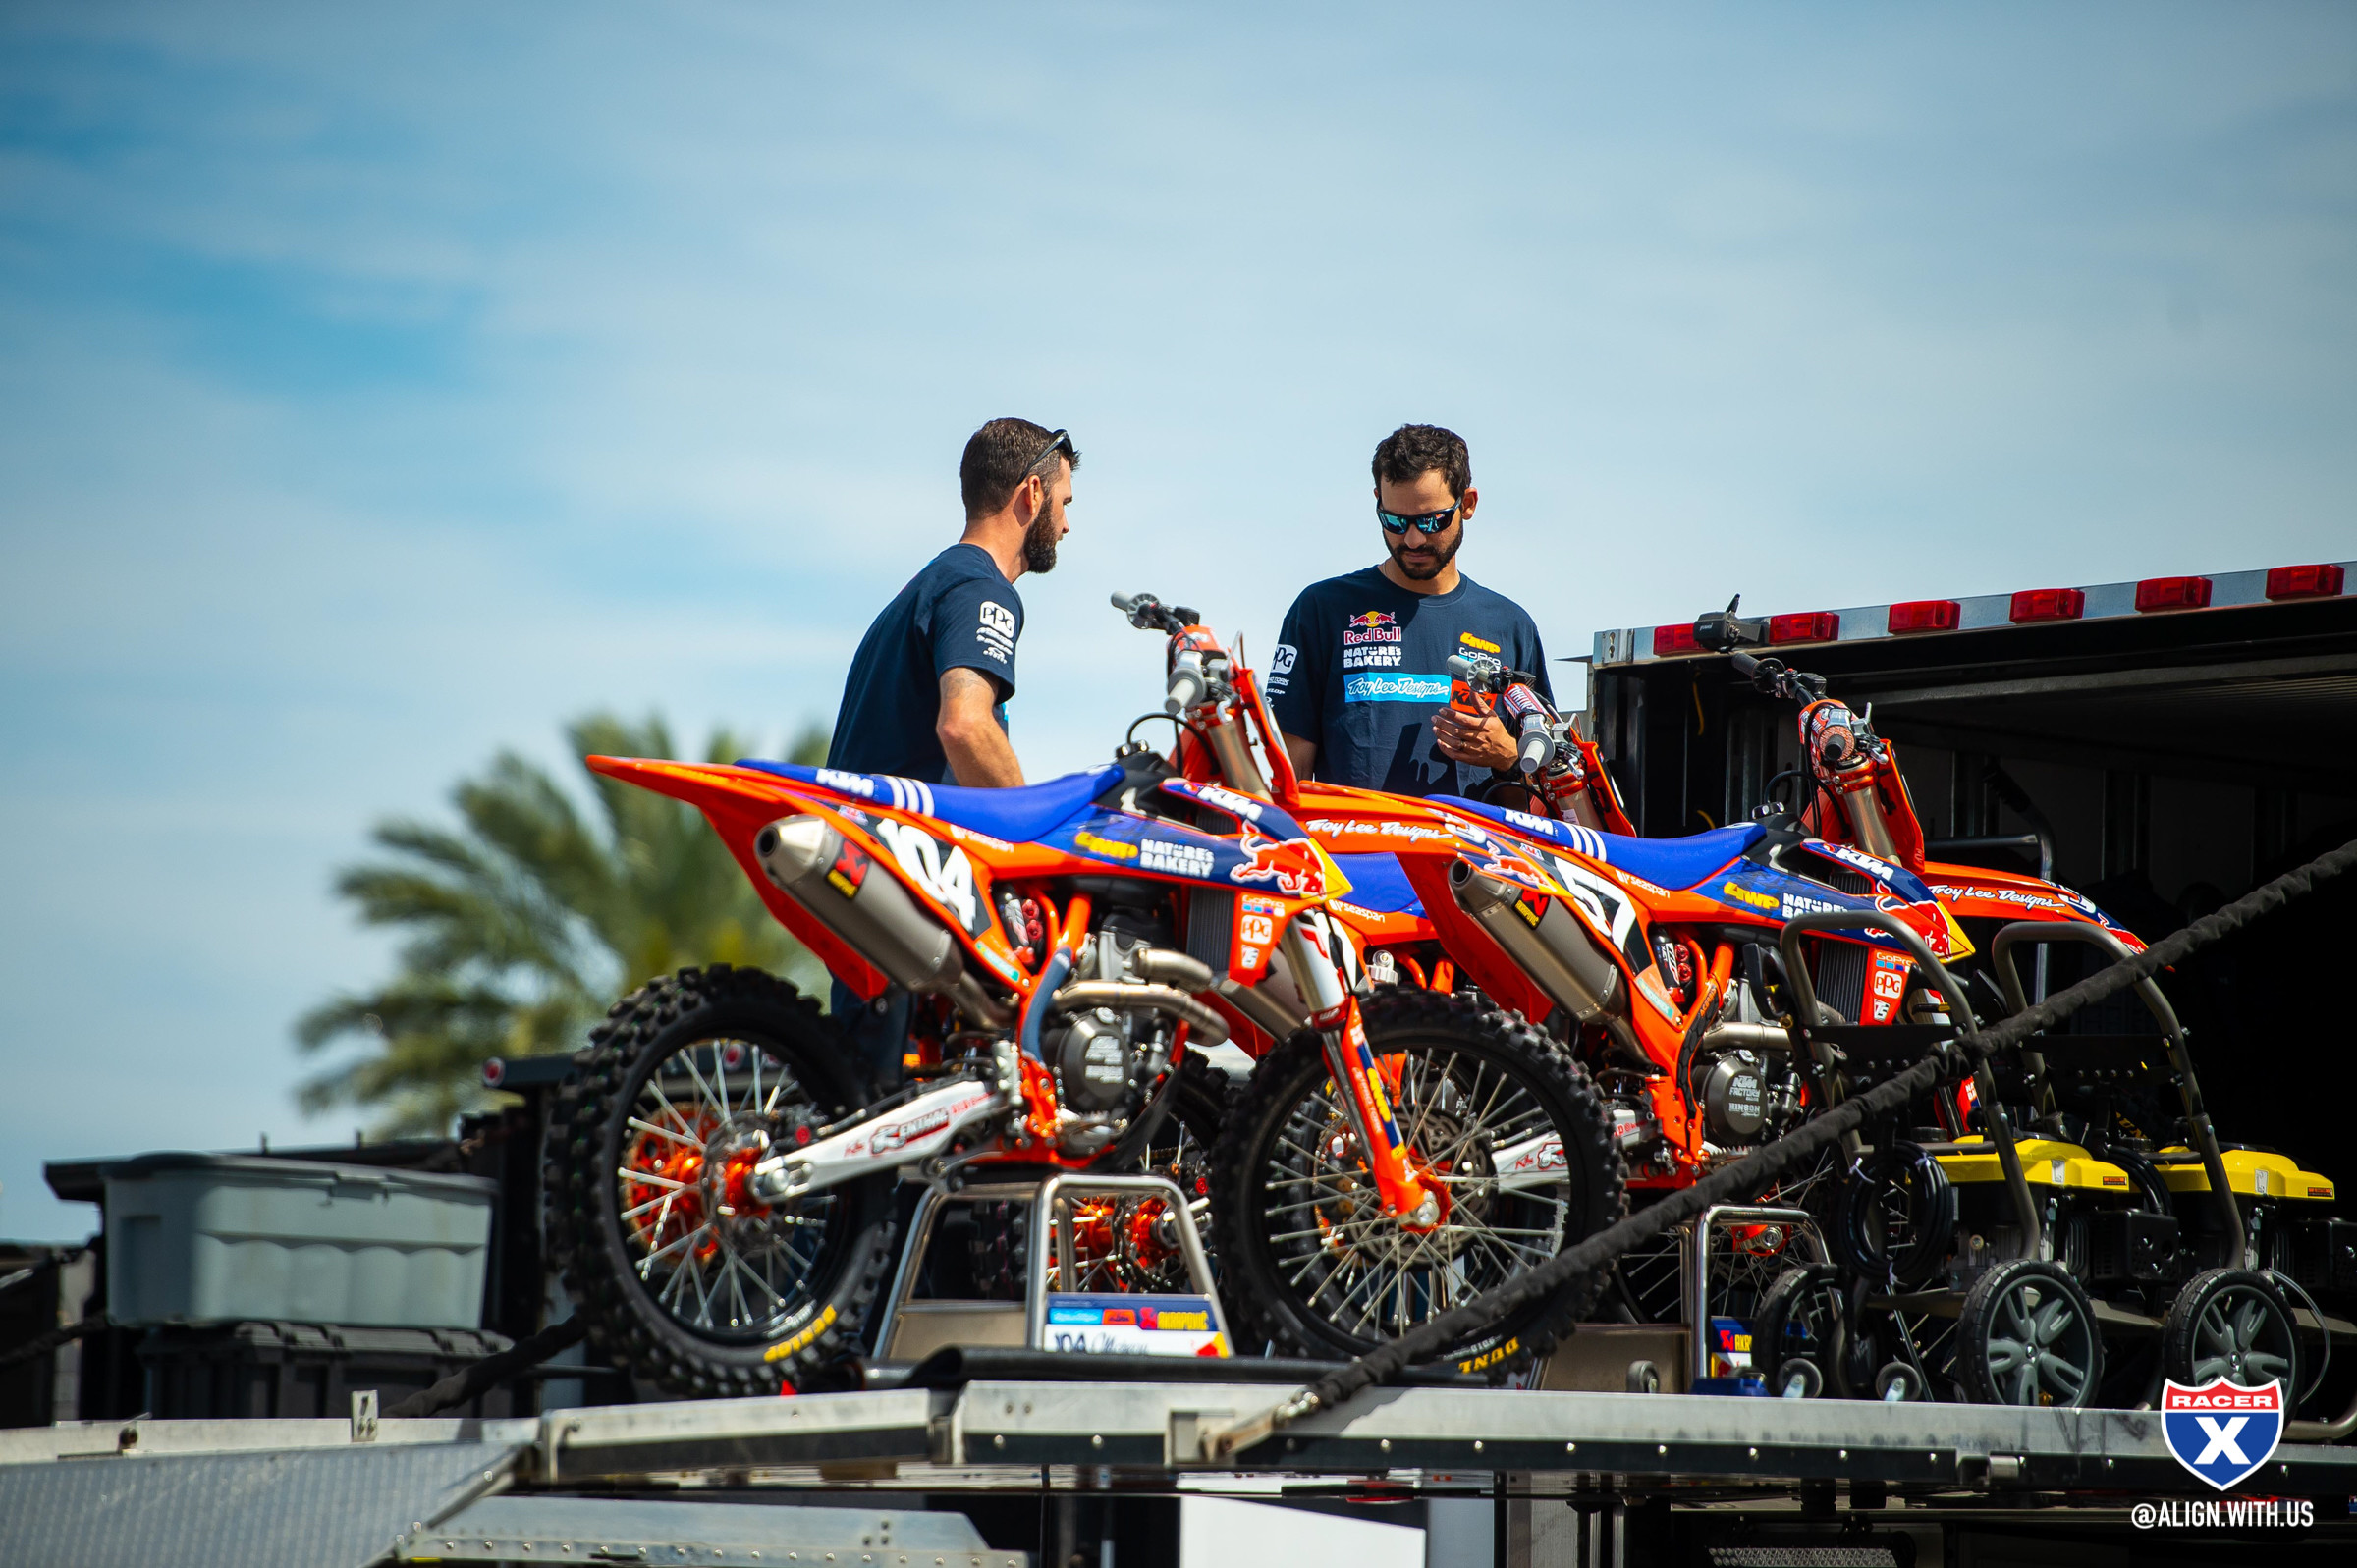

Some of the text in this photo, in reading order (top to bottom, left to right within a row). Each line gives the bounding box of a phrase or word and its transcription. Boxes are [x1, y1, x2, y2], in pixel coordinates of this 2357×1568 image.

[983, 607, 1014, 631] PPG
[1344, 626, 1401, 645] Red Bull
[1343, 656, 1402, 668] BAKERY
[1347, 677, 1450, 698] Troy Lee Designs
[815, 768, 874, 798] KTM
[1306, 818, 1453, 843] Troy Lee Designs
[1504, 809, 1554, 836] KTM
[876, 817, 977, 932] 104
[1139, 851, 1214, 878] BAKERY
[1835, 847, 1894, 881] KTM
[1928, 884, 2065, 911] Troy Lee Designs
[1343, 902, 1386, 923] seaspan
[1876, 951, 1913, 967] GoPro
[1875, 974, 1901, 995] PPG
[1458, 1336, 1520, 1374] DUNL
